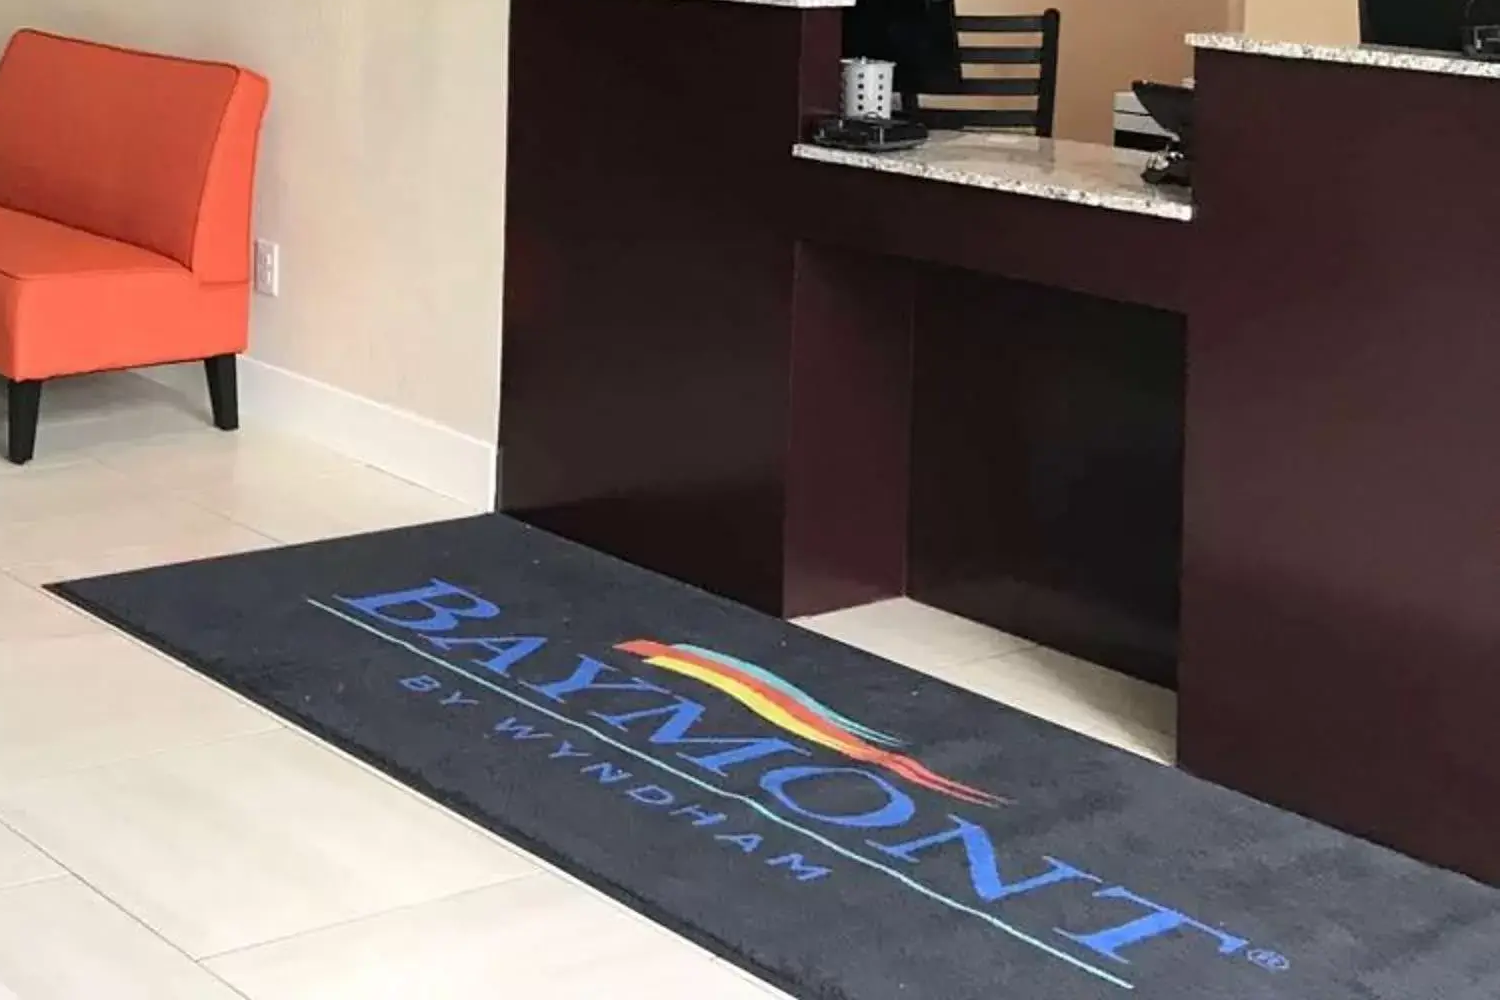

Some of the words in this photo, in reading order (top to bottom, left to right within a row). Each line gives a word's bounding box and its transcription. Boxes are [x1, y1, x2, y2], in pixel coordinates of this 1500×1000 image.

[331, 577, 1249, 964] BAYMONT
[398, 674, 480, 706] BY
[483, 716, 833, 881] WYNDHAM
